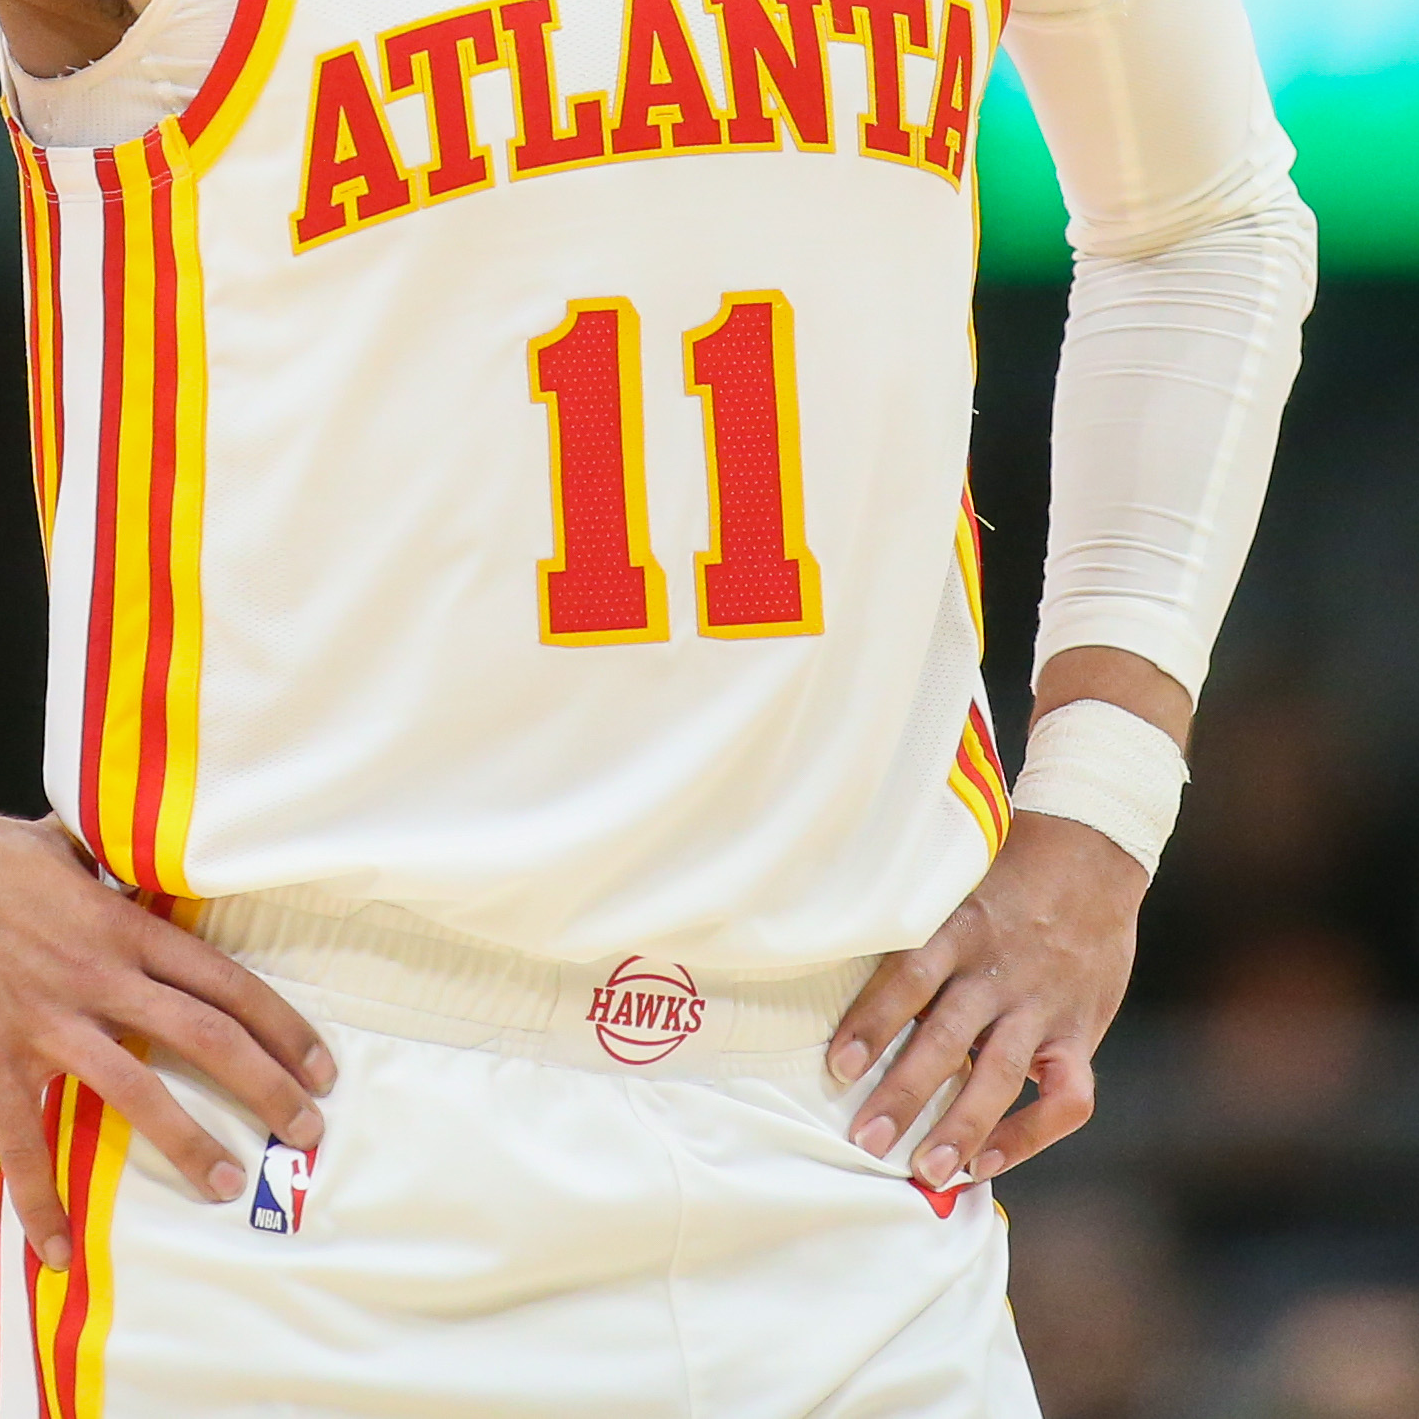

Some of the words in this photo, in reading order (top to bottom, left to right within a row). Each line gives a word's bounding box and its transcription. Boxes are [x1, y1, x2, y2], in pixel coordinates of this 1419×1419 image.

[527, 288, 825, 648] 11
[586, 987, 706, 1033] HAWKS
[254, 1207, 282, 1231] NBA
